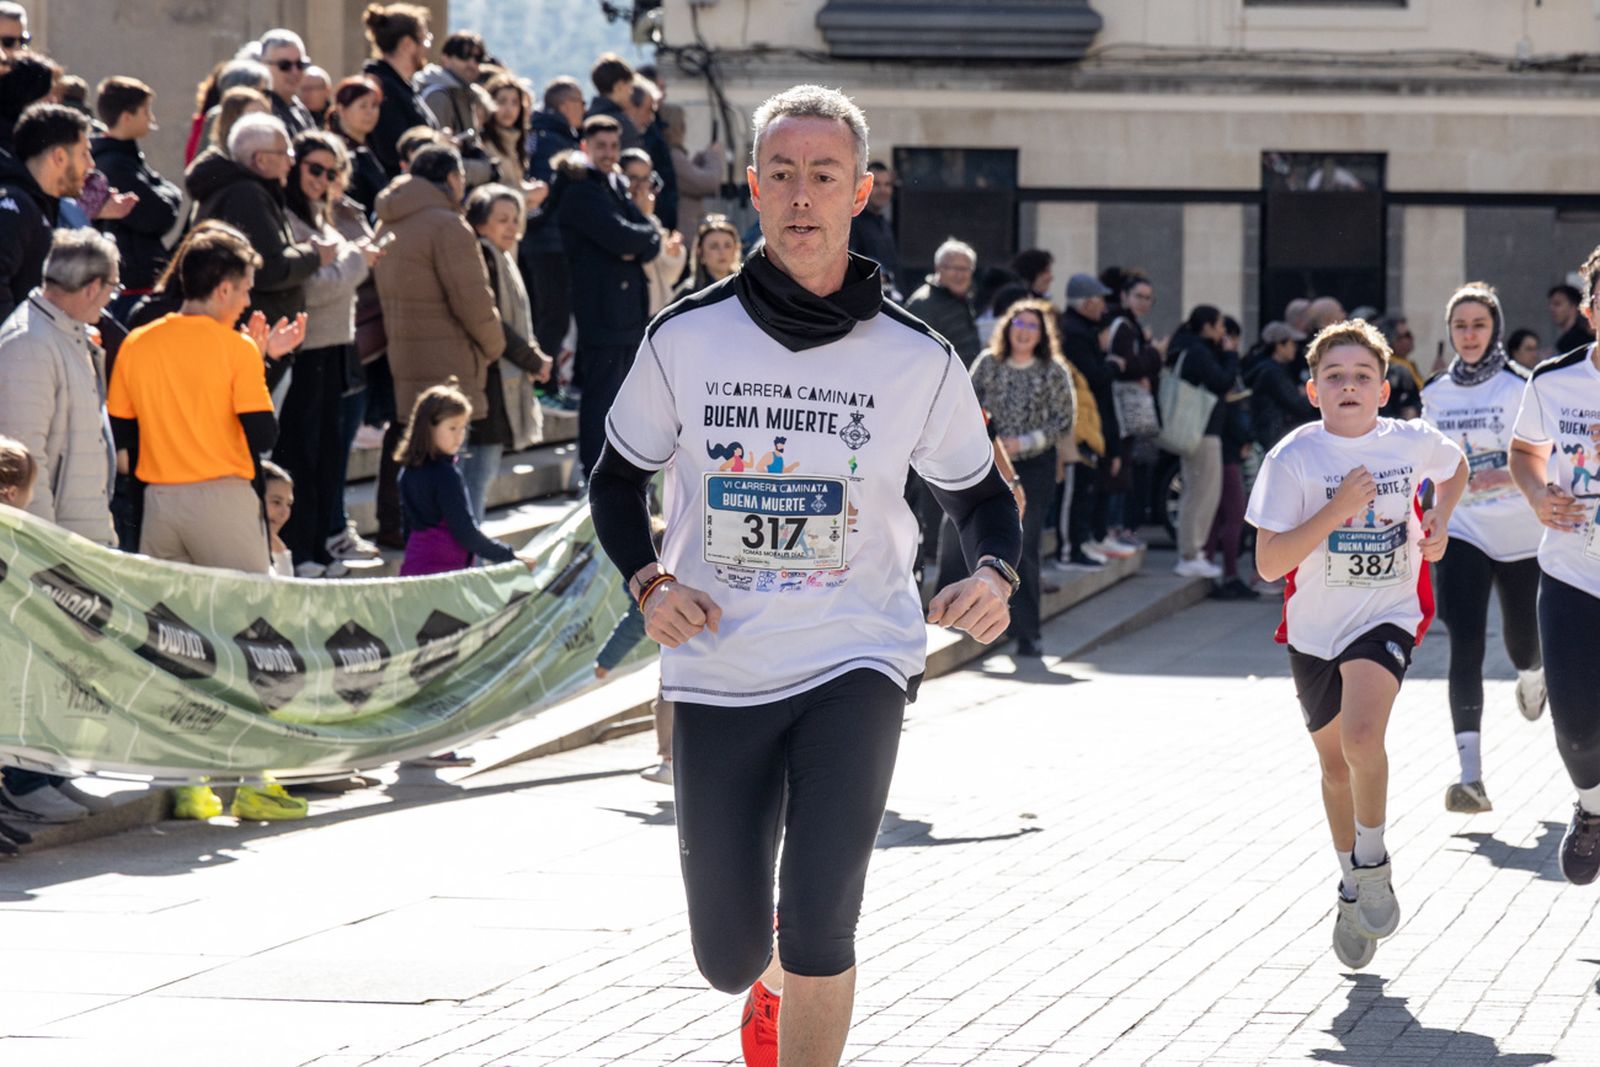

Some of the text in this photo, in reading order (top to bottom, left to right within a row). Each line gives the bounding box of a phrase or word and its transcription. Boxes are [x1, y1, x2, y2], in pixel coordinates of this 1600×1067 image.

[705, 381, 875, 409] VI CARRERA CAMINATA
[703, 404, 839, 435] BUENA MUERTE
[1560, 407, 1570, 416] VI
[722, 480, 828, 493] VI CARRERA CAMINATA
[1376, 480, 1400, 496] ERTE
[722, 492, 806, 512] BUENA MUERTE
[741, 514, 808, 551] 317
[1337, 541, 1363, 552] BUENA
[1348, 552, 1396, 577] 387
[158, 622, 207, 660] ownat
[248, 643, 297, 673] ownat
[338, 641, 382, 674] ownat
